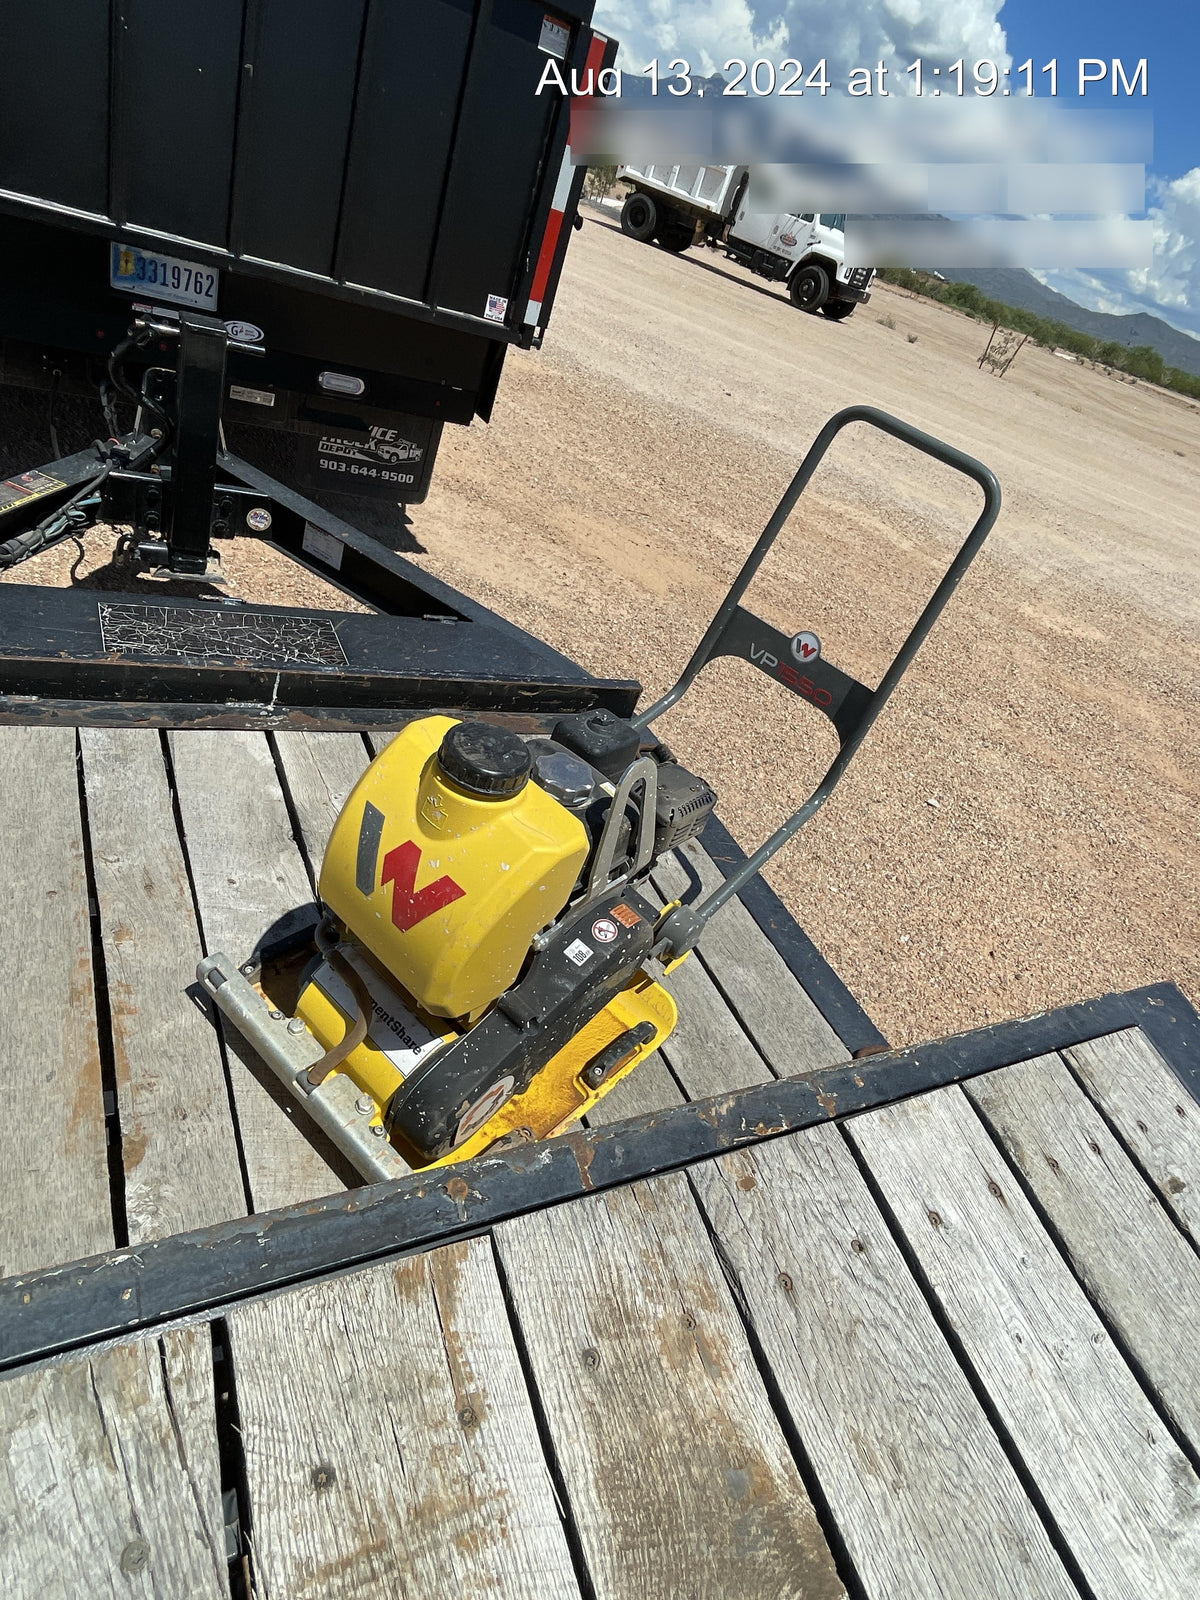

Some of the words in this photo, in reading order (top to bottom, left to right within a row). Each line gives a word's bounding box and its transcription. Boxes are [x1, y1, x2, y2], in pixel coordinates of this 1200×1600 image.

[136, 257, 214, 298] 3319762
[749, 642, 832, 706] VP1550
[572, 950, 587, 964] 108
